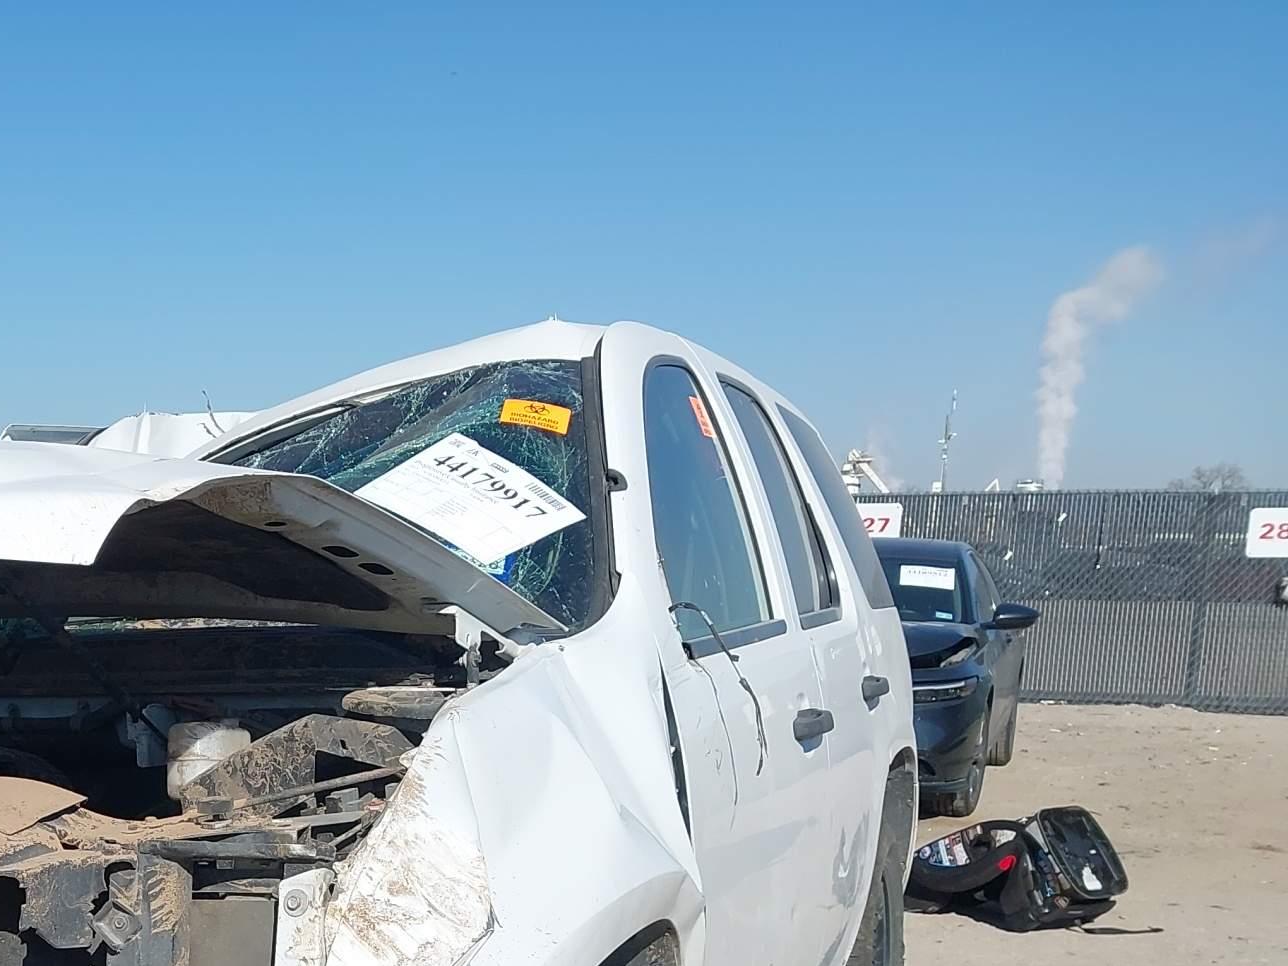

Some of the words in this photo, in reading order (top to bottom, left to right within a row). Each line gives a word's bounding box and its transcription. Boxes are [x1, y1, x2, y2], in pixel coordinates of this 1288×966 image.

[510, 412, 559, 425] BIOHAZARD
[433, 455, 548, 518] 44179917
[863, 517, 890, 533] 27
[1259, 523, 1288, 539] 28
